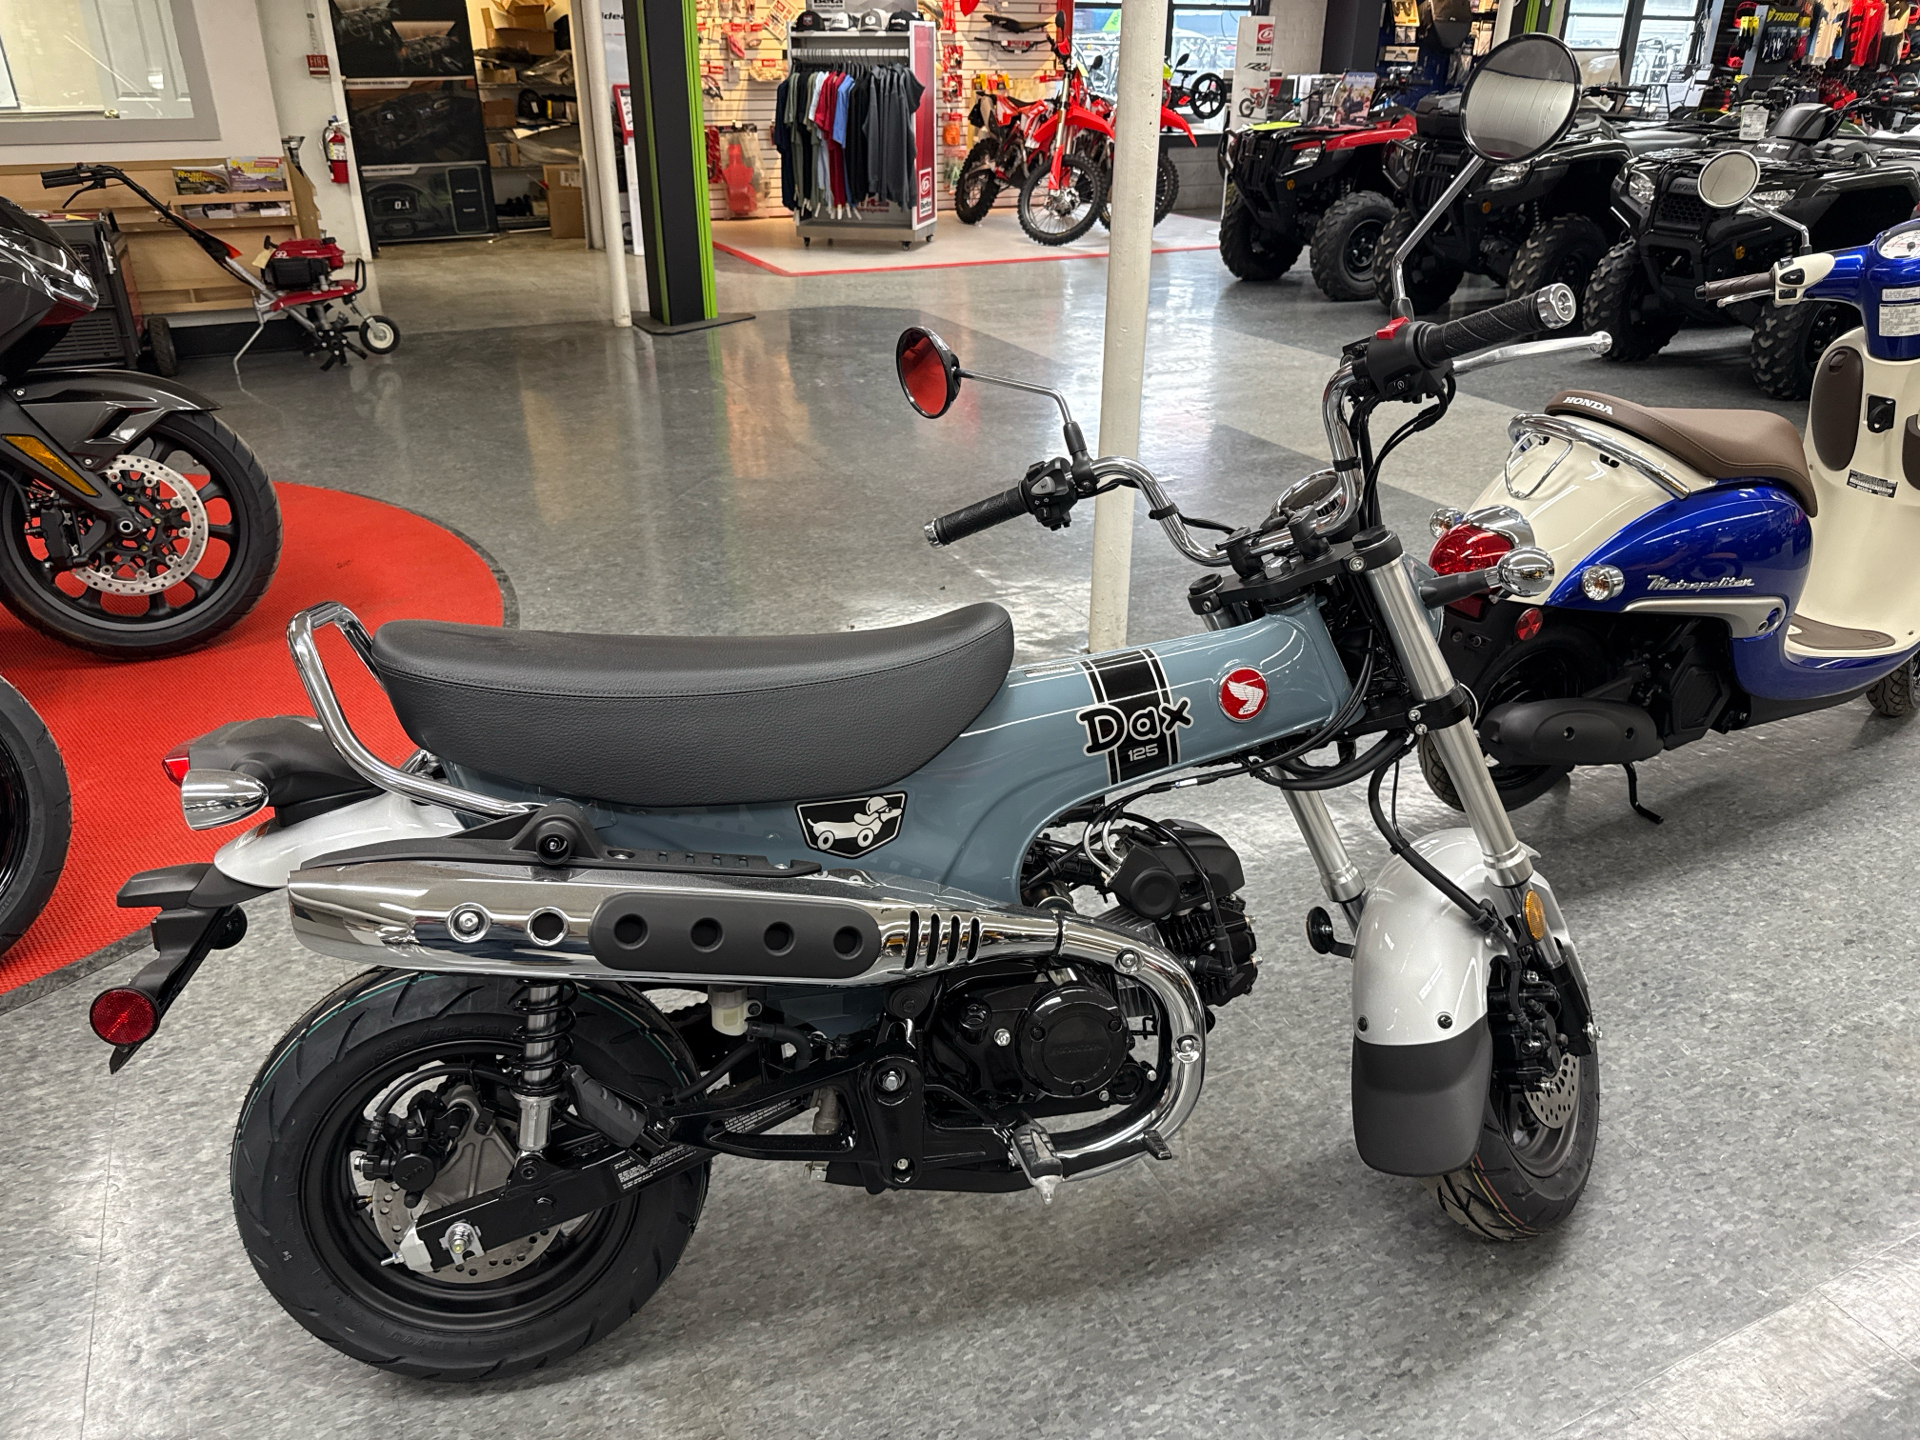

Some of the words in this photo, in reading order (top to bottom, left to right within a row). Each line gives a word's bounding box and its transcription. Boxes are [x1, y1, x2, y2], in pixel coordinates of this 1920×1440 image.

[1774, 12, 1799, 21] THOR
[309, 56, 326, 67] FIRE
[1562, 396, 1613, 415] HONDA
[1647, 574, 1755, 592] Metropolitan
[1076, 697, 1194, 757] Dax
[1127, 743, 1159, 762] 125
